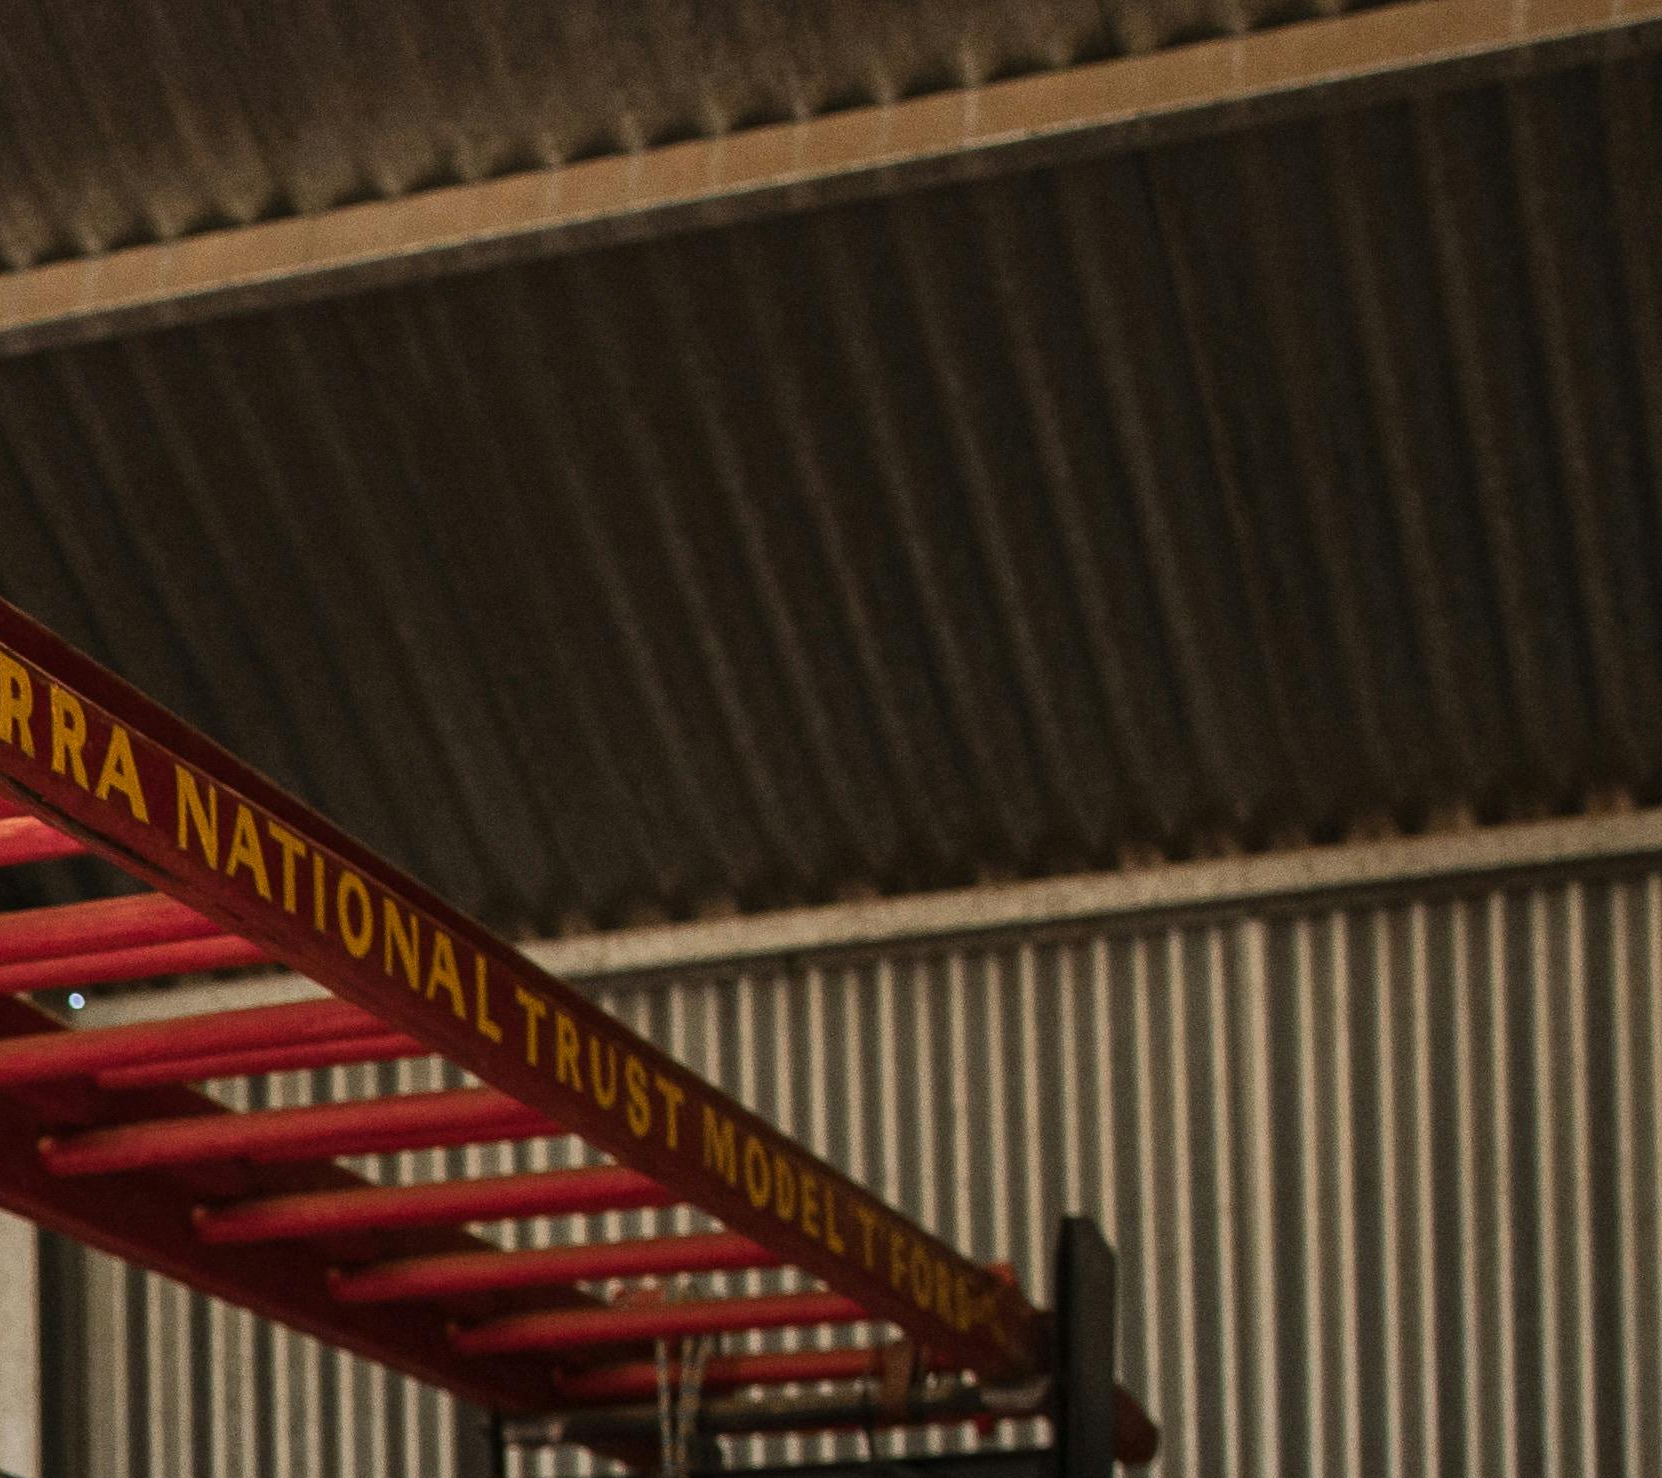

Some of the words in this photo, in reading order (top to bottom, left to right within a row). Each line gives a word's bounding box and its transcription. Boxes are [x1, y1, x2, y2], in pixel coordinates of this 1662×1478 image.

[174, 762, 503, 1044] NATIONAL
[517, 986, 683, 1151] TRUST
[704, 1104, 845, 1255] MODEL
